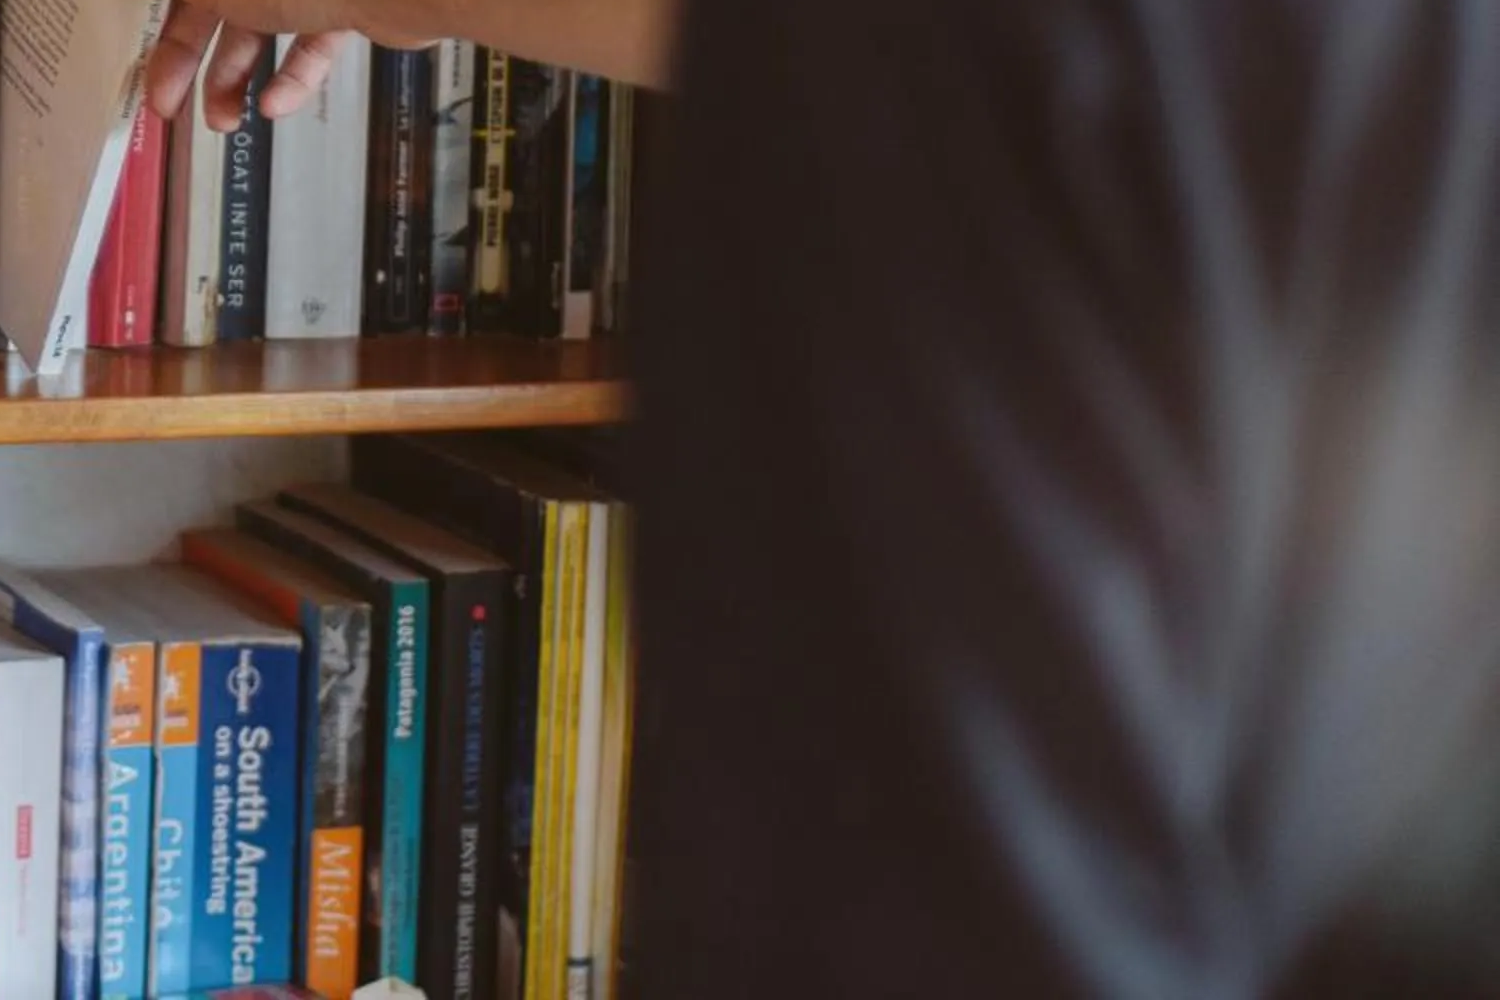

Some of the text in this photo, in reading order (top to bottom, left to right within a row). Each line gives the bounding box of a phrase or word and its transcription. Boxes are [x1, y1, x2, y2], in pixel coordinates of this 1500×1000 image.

[232, 132, 252, 192] ÖGAT
[227, 264, 245, 309] SER
[229, 202, 248, 254] INTE
[393, 605, 417, 739] Patagonia 2016
[103, 760, 138, 983] Argentina
[205, 726, 232, 914] on a shoestring
[231, 725, 272, 985] South America
[314, 840, 355, 958] Misha
